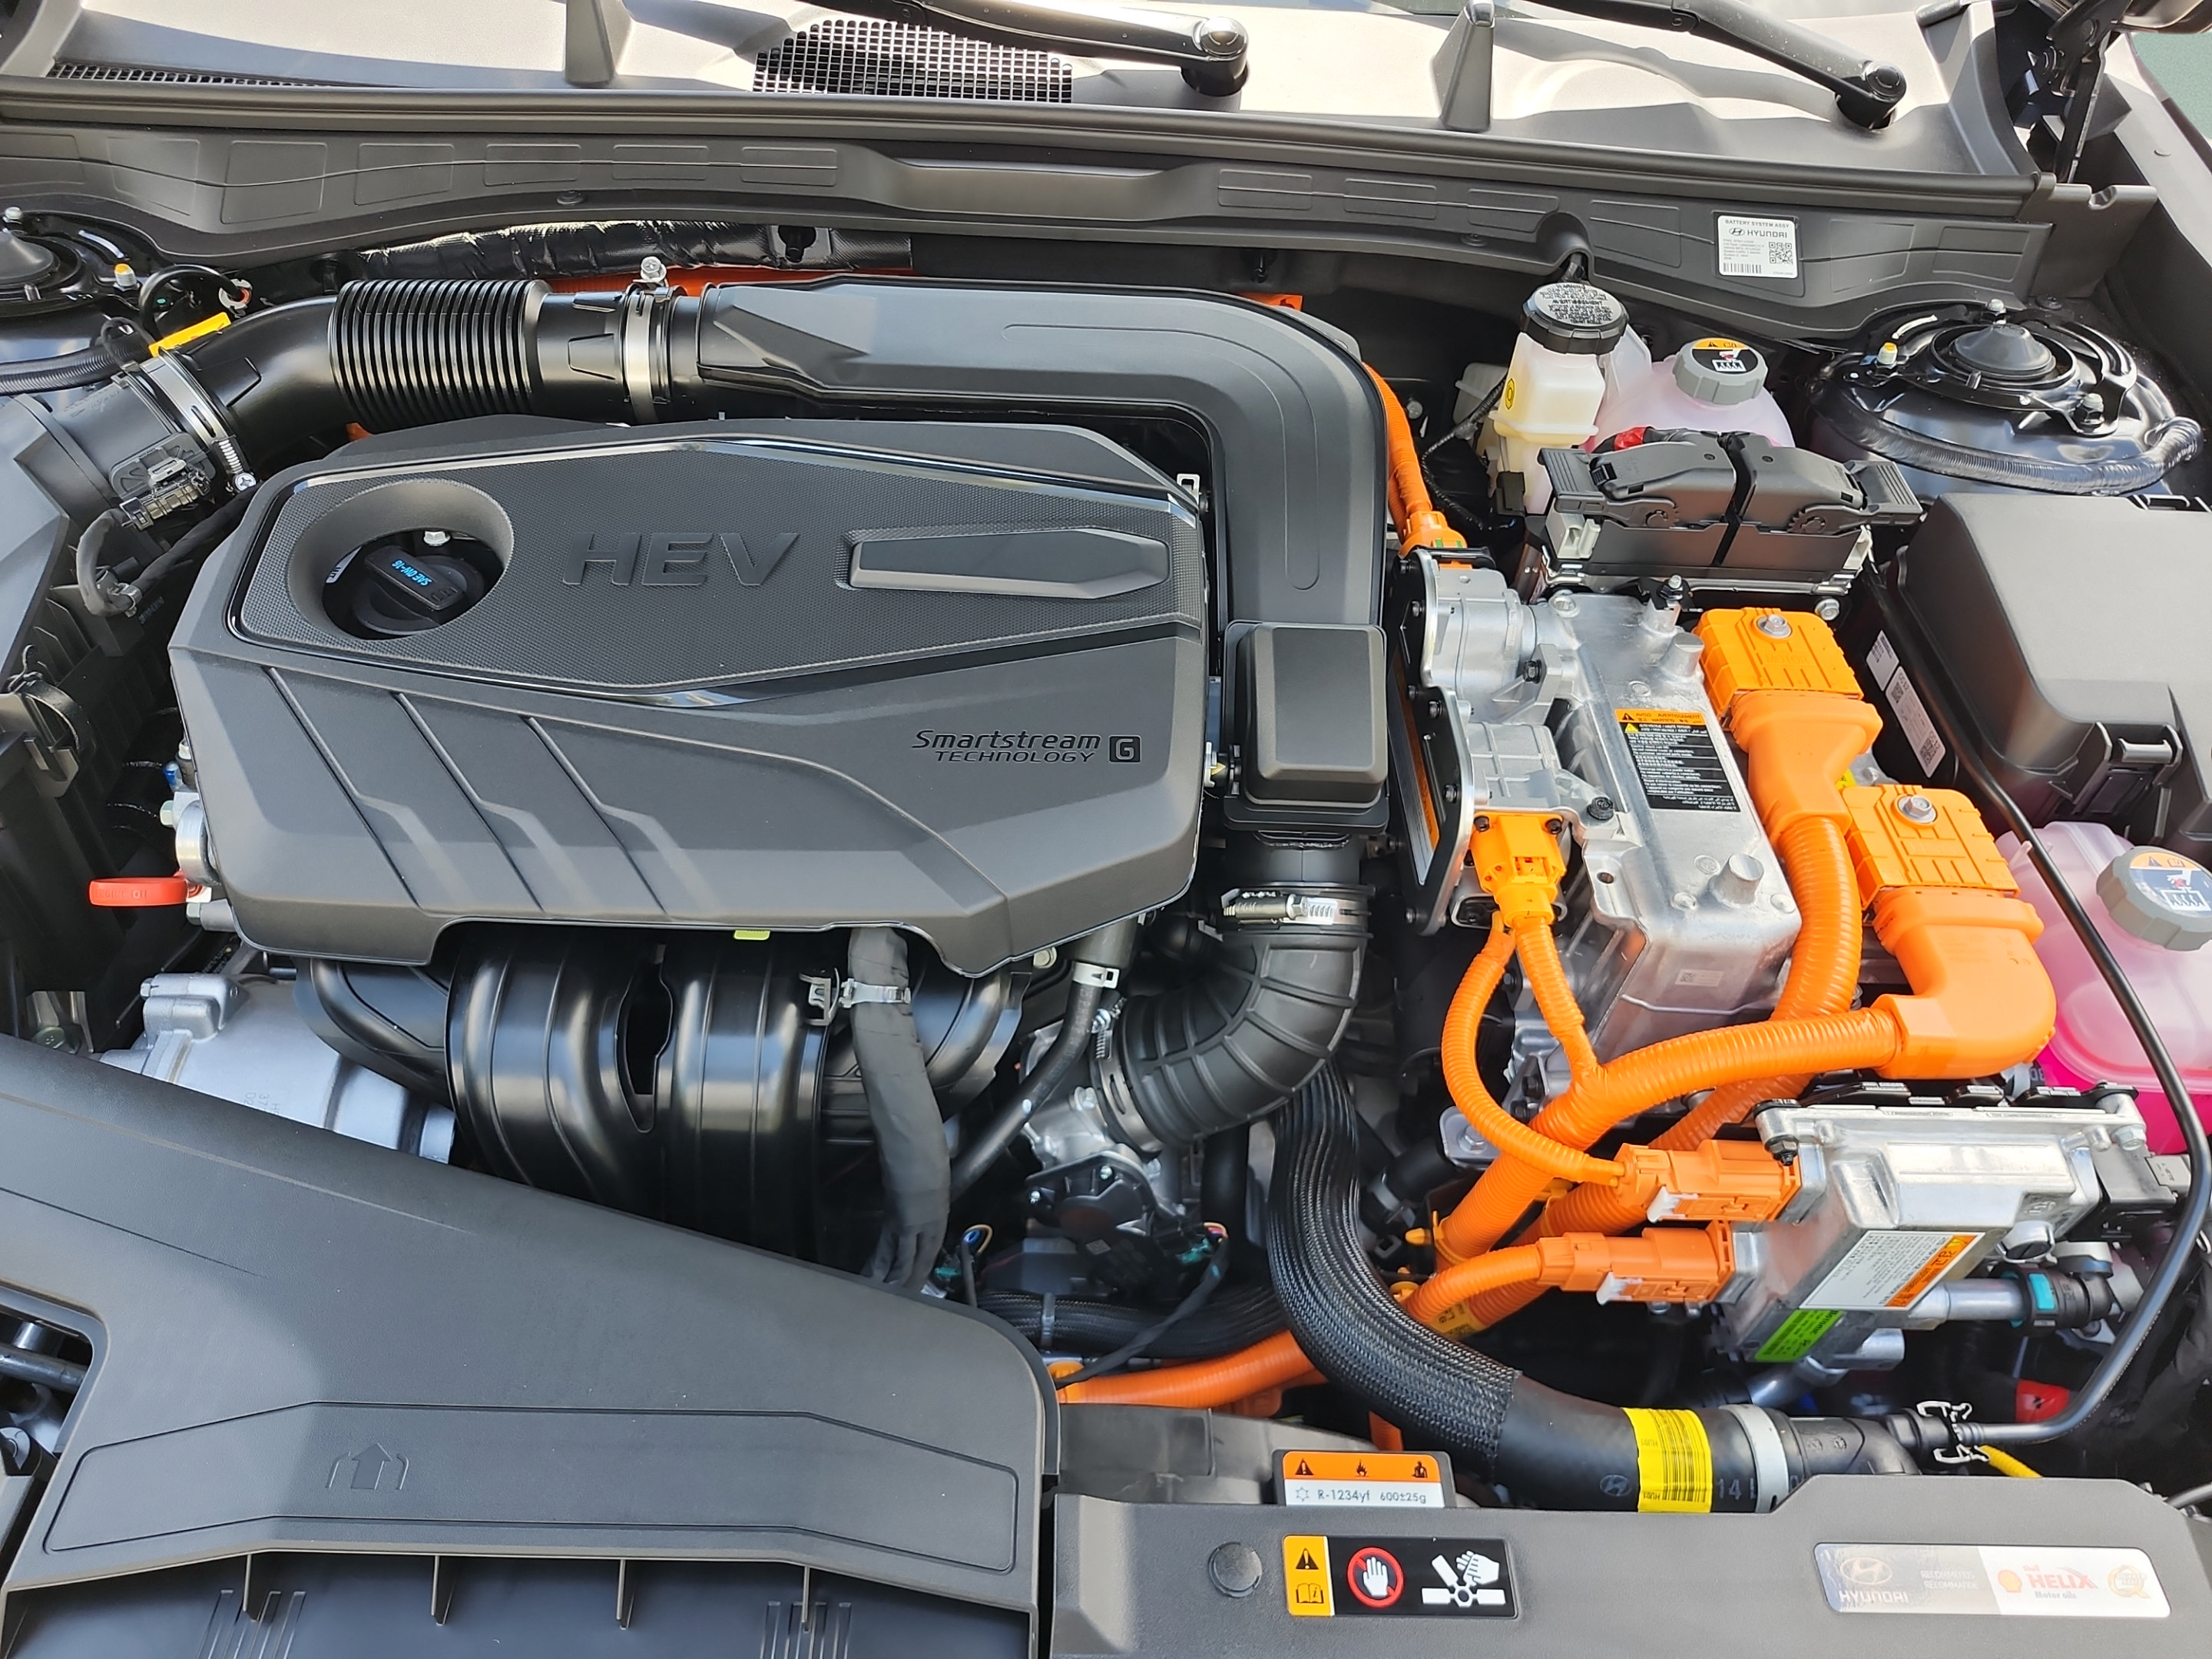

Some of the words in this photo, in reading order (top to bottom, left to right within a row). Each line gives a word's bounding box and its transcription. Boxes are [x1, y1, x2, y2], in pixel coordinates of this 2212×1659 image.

[1747, 230, 1788, 238] HYUNDAI
[562, 532, 800, 586] HEV
[390, 559, 419, 578] 0W-16
[912, 730, 1101, 749] Smartstream
[1115, 738, 1136, 760] G
[934, 750, 1095, 763] TECHNOLOGY
[1318, 1489, 1370, 1502] R-1234yf
[1380, 1492, 1426, 1504] 600±25g
[1920, 1571, 1975, 1579] RECOMMENDS
[2027, 1574, 2095, 1589] HELIX
[1923, 1581, 1979, 1590] RECOMMANDE
[1839, 1590, 1909, 1604] HYUNDAI
[2062, 1590, 2077, 1599] oils
